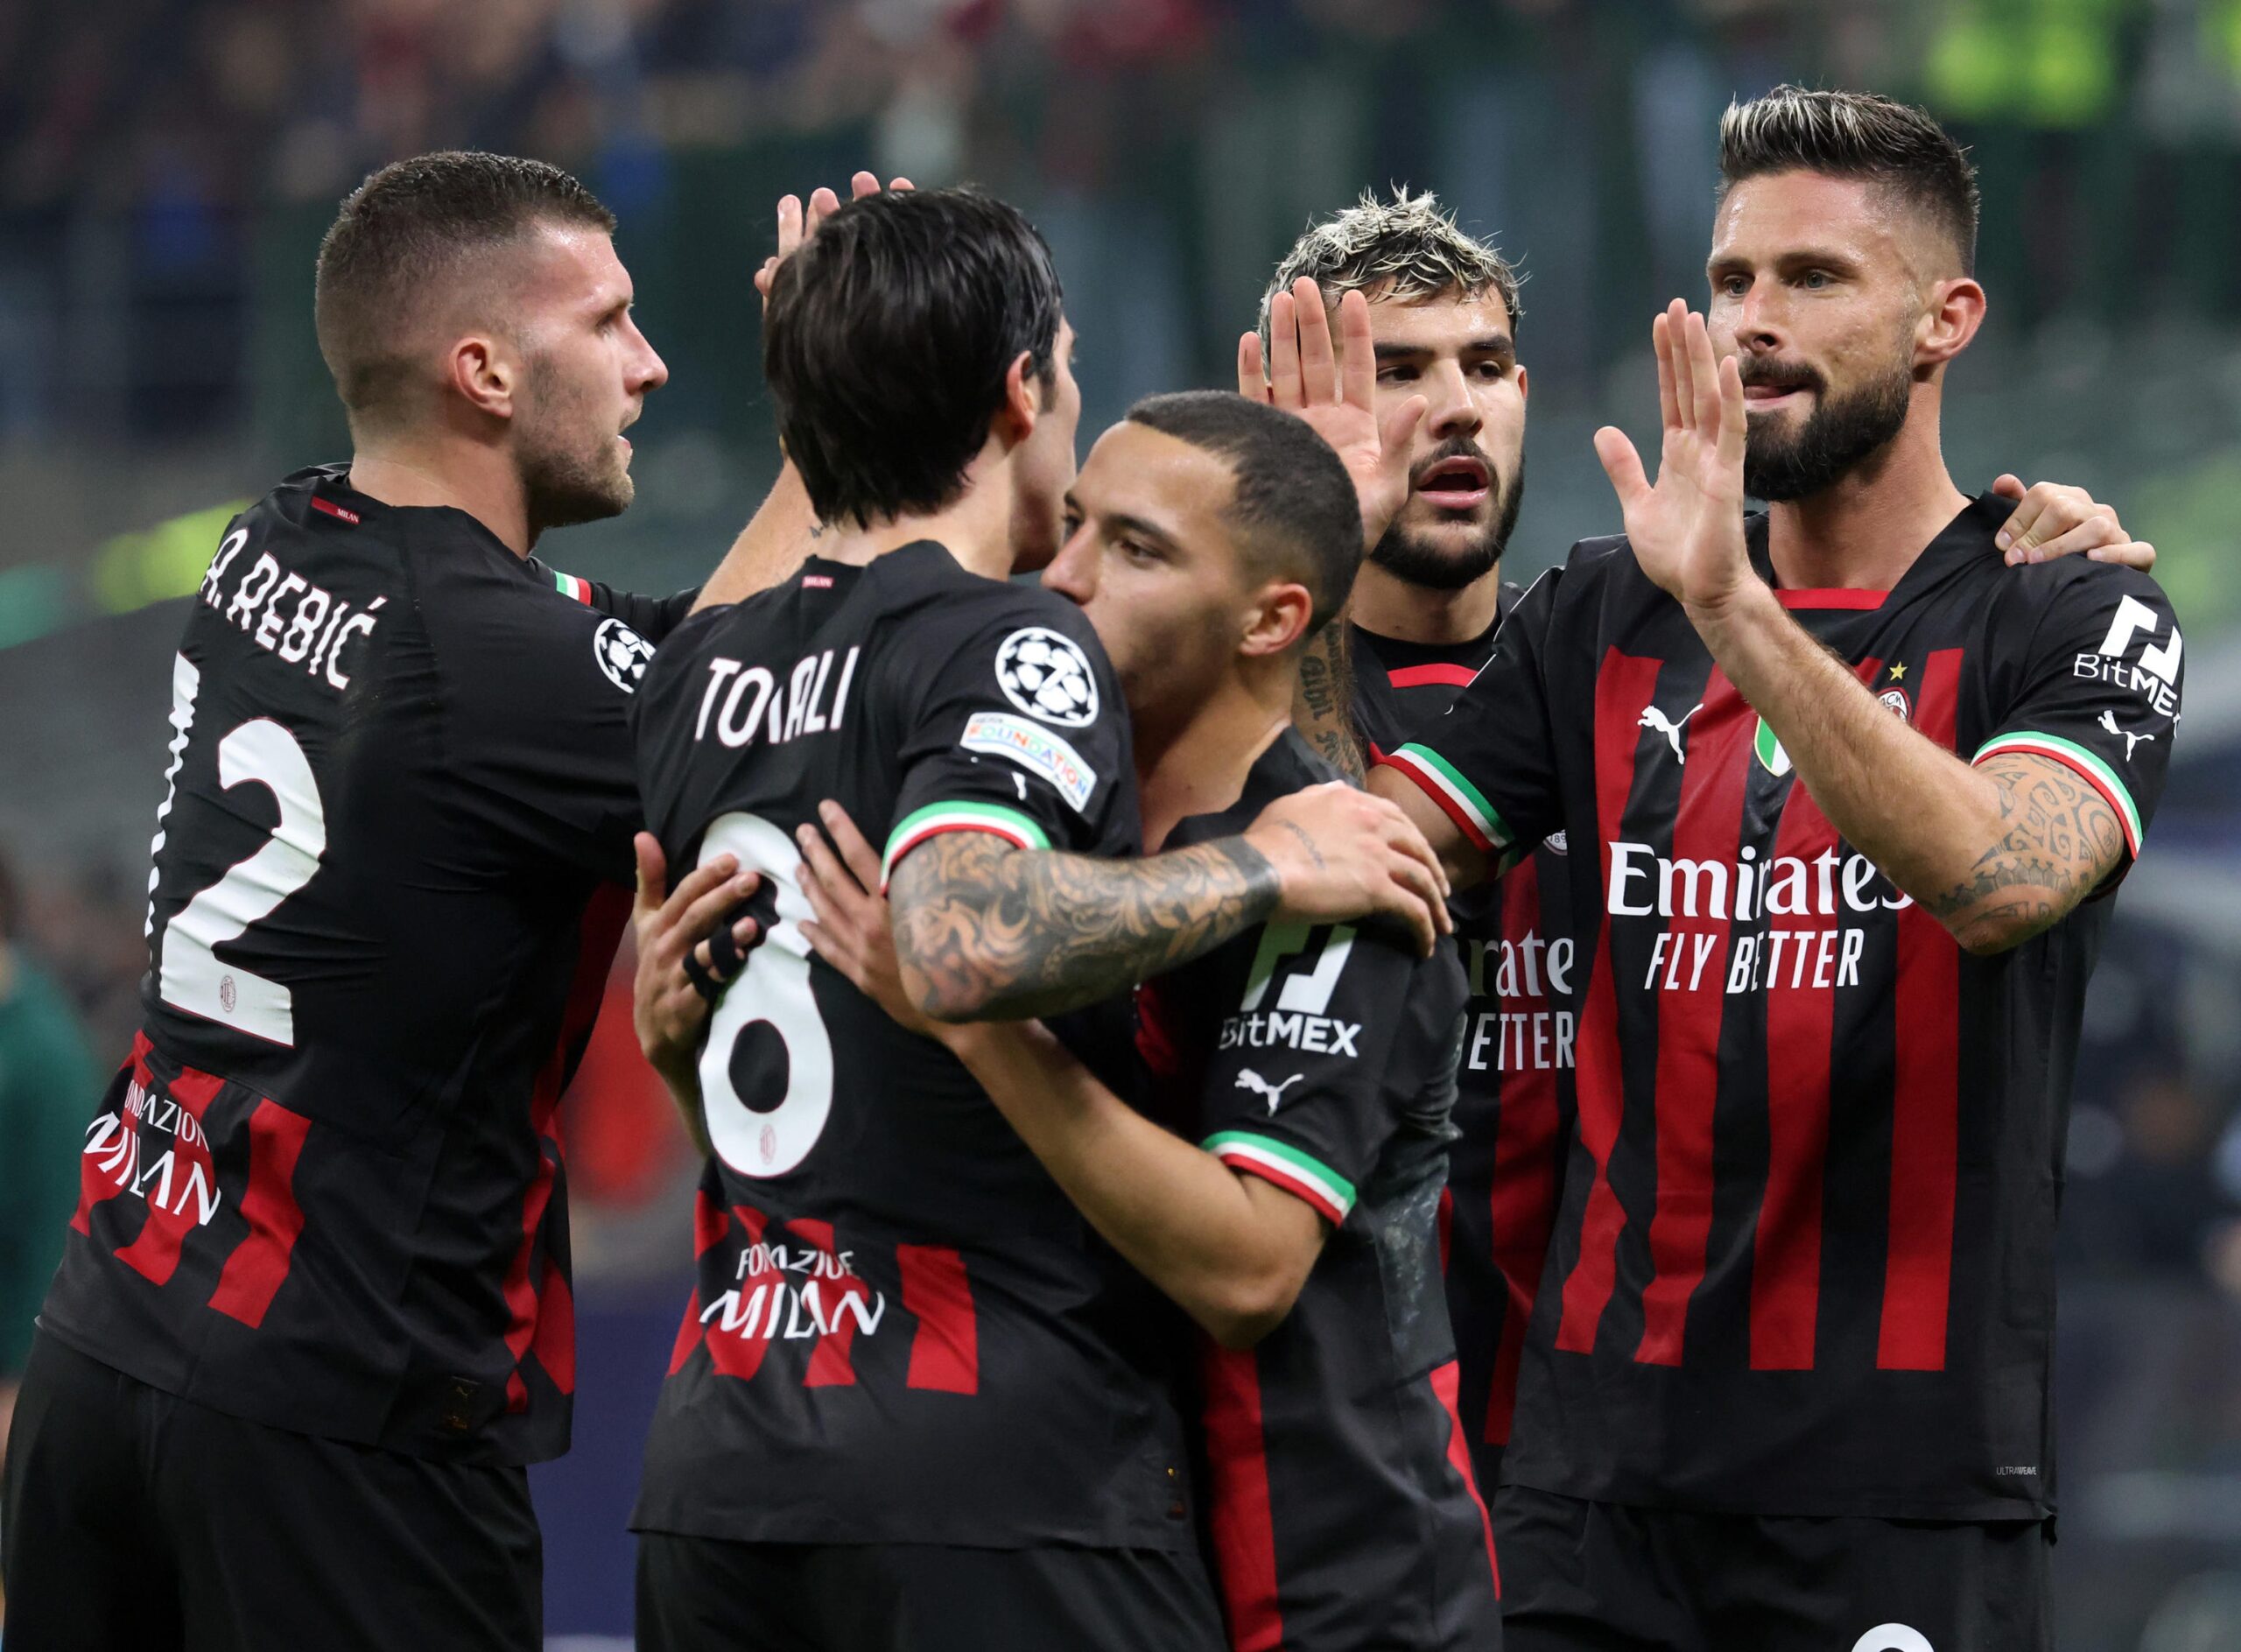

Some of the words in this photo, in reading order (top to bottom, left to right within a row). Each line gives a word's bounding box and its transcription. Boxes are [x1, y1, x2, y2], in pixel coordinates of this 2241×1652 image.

[336, 508, 360, 524] MILAN
[227, 550, 388, 690] REBIĆ
[967, 724, 1087, 796] FOUNDATION
[1644, 932, 1718, 991] FLY
[1725, 928, 1865, 995] BETTER
[1219, 1010, 1362, 1058] BitMEX
[1468, 1011, 1576, 1071] ETTER
[83, 1111, 221, 1226] MILAN
[699, 1280, 885, 1339] MILAN
